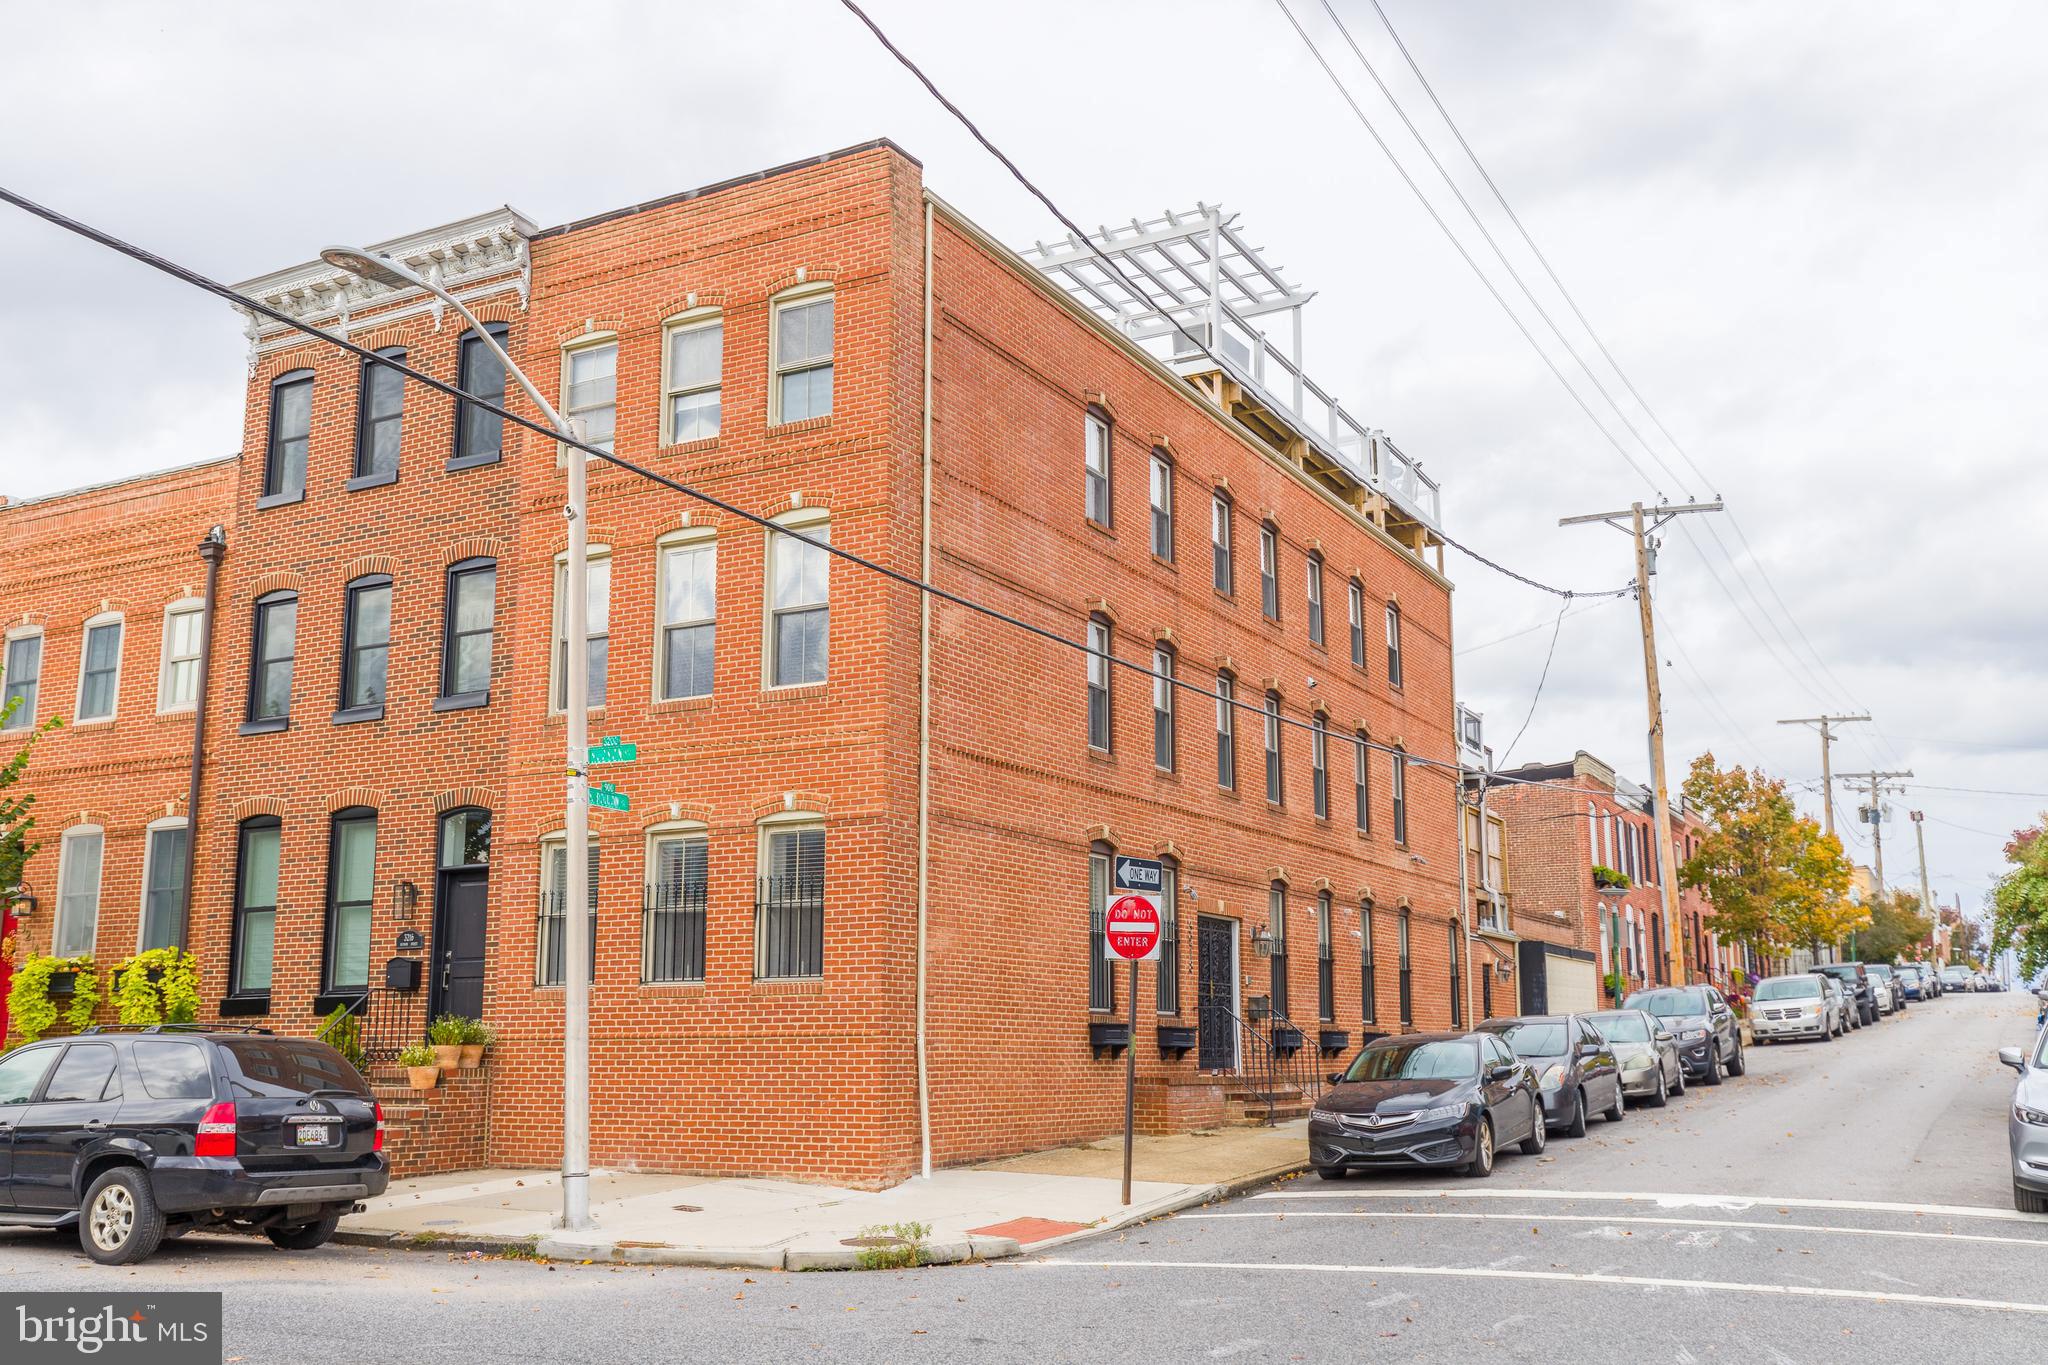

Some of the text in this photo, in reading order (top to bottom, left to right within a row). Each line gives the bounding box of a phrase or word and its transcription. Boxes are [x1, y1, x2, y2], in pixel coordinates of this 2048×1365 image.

[604, 783, 614, 793] 900
[1129, 868, 1158, 881] ONE WAY
[1114, 909, 1153, 920] DO NOT
[1117, 936, 1149, 947] ENTER
